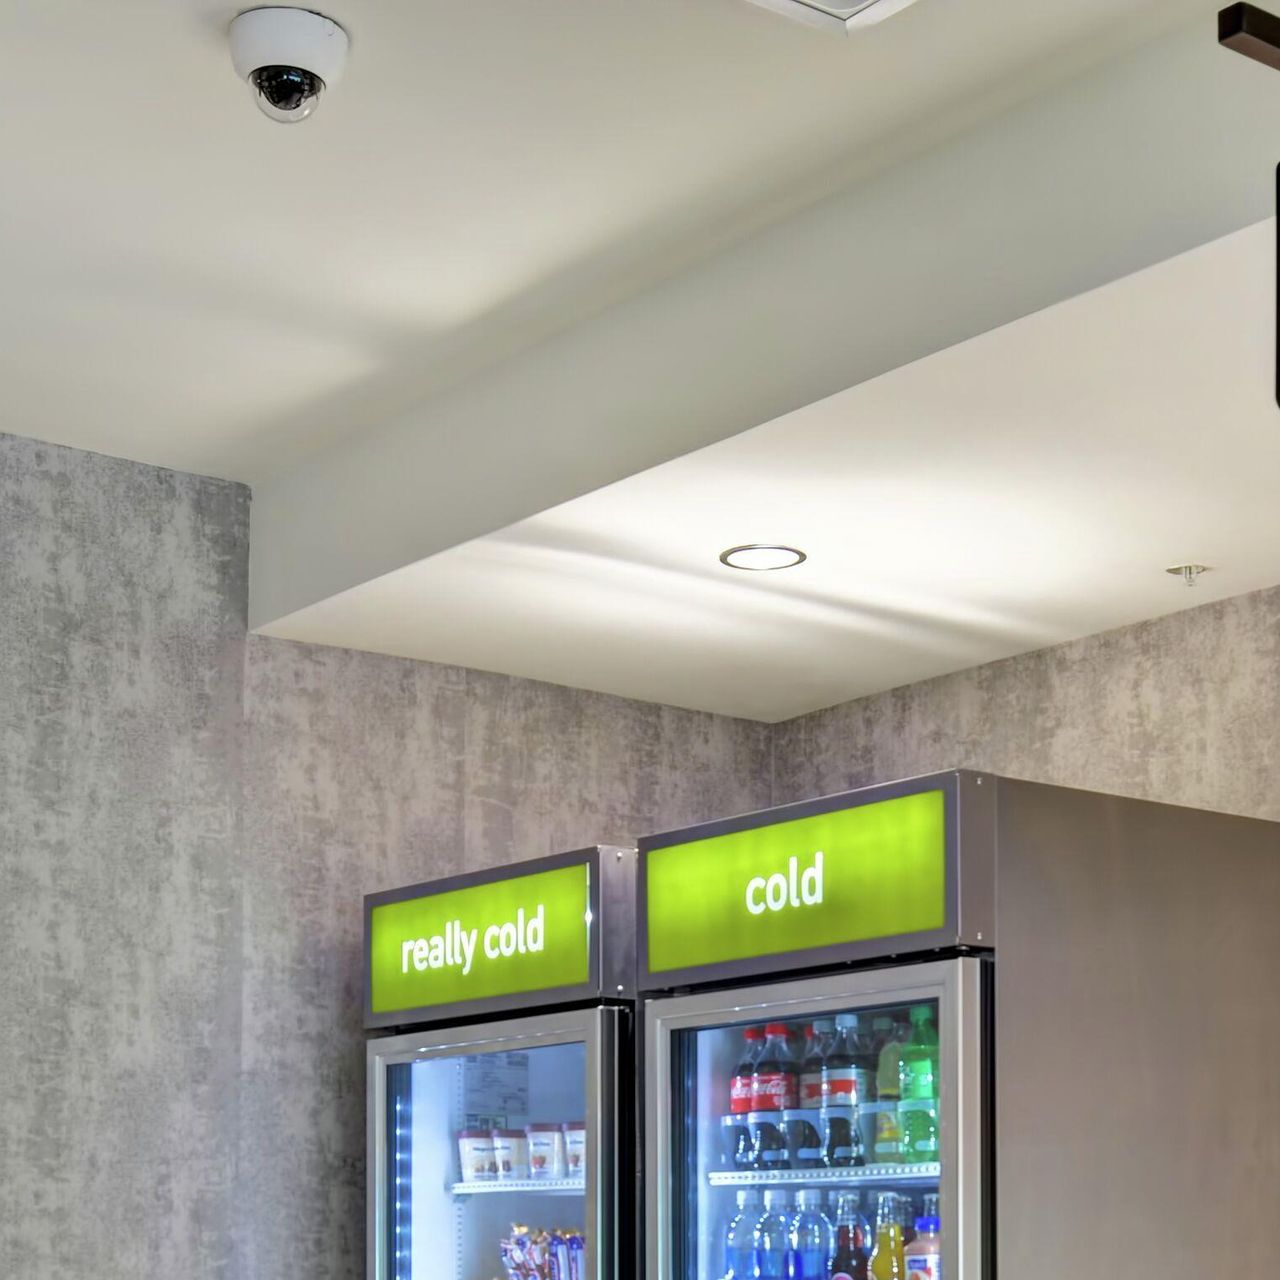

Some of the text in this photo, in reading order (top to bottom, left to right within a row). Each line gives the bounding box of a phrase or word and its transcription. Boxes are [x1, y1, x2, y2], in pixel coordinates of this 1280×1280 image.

[745, 851, 824, 915] cold
[401, 904, 545, 976] really cold
